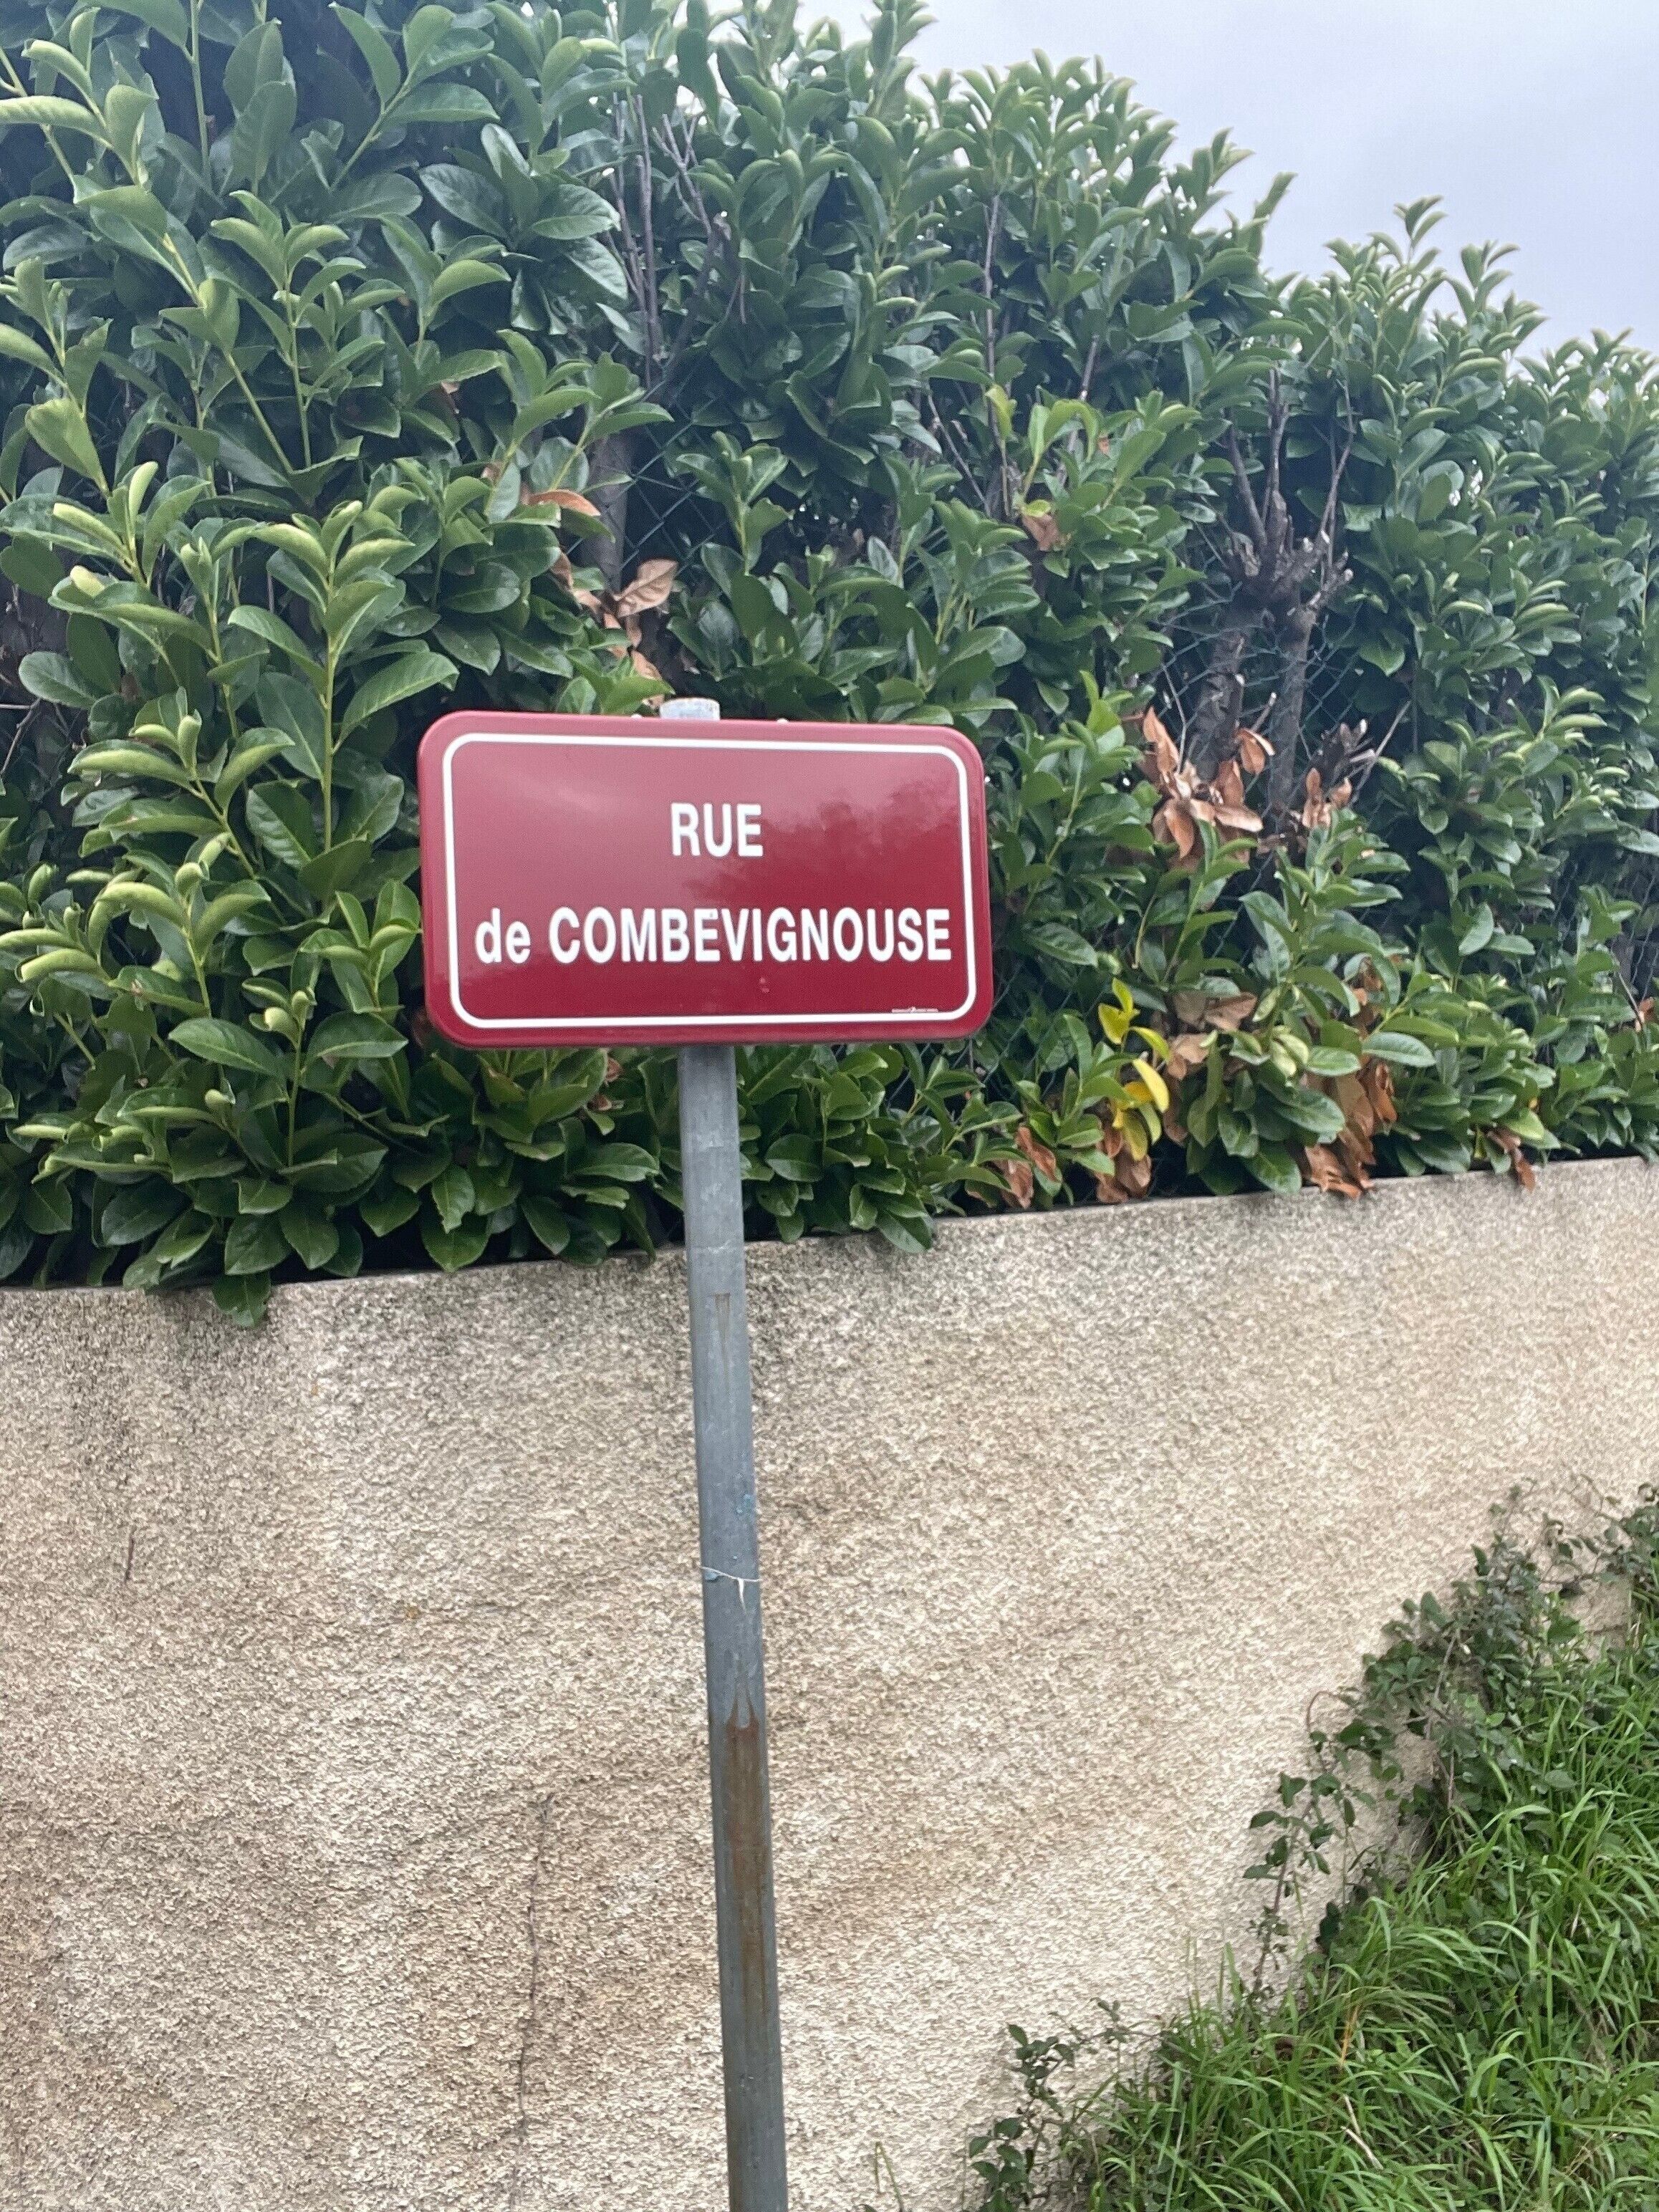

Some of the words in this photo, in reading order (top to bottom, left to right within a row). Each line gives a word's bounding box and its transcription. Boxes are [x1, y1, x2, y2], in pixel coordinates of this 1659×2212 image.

[669, 801, 764, 858] RUE
[473, 907, 532, 965] de
[548, 905, 953, 964] COMBEVIGNOUSE
